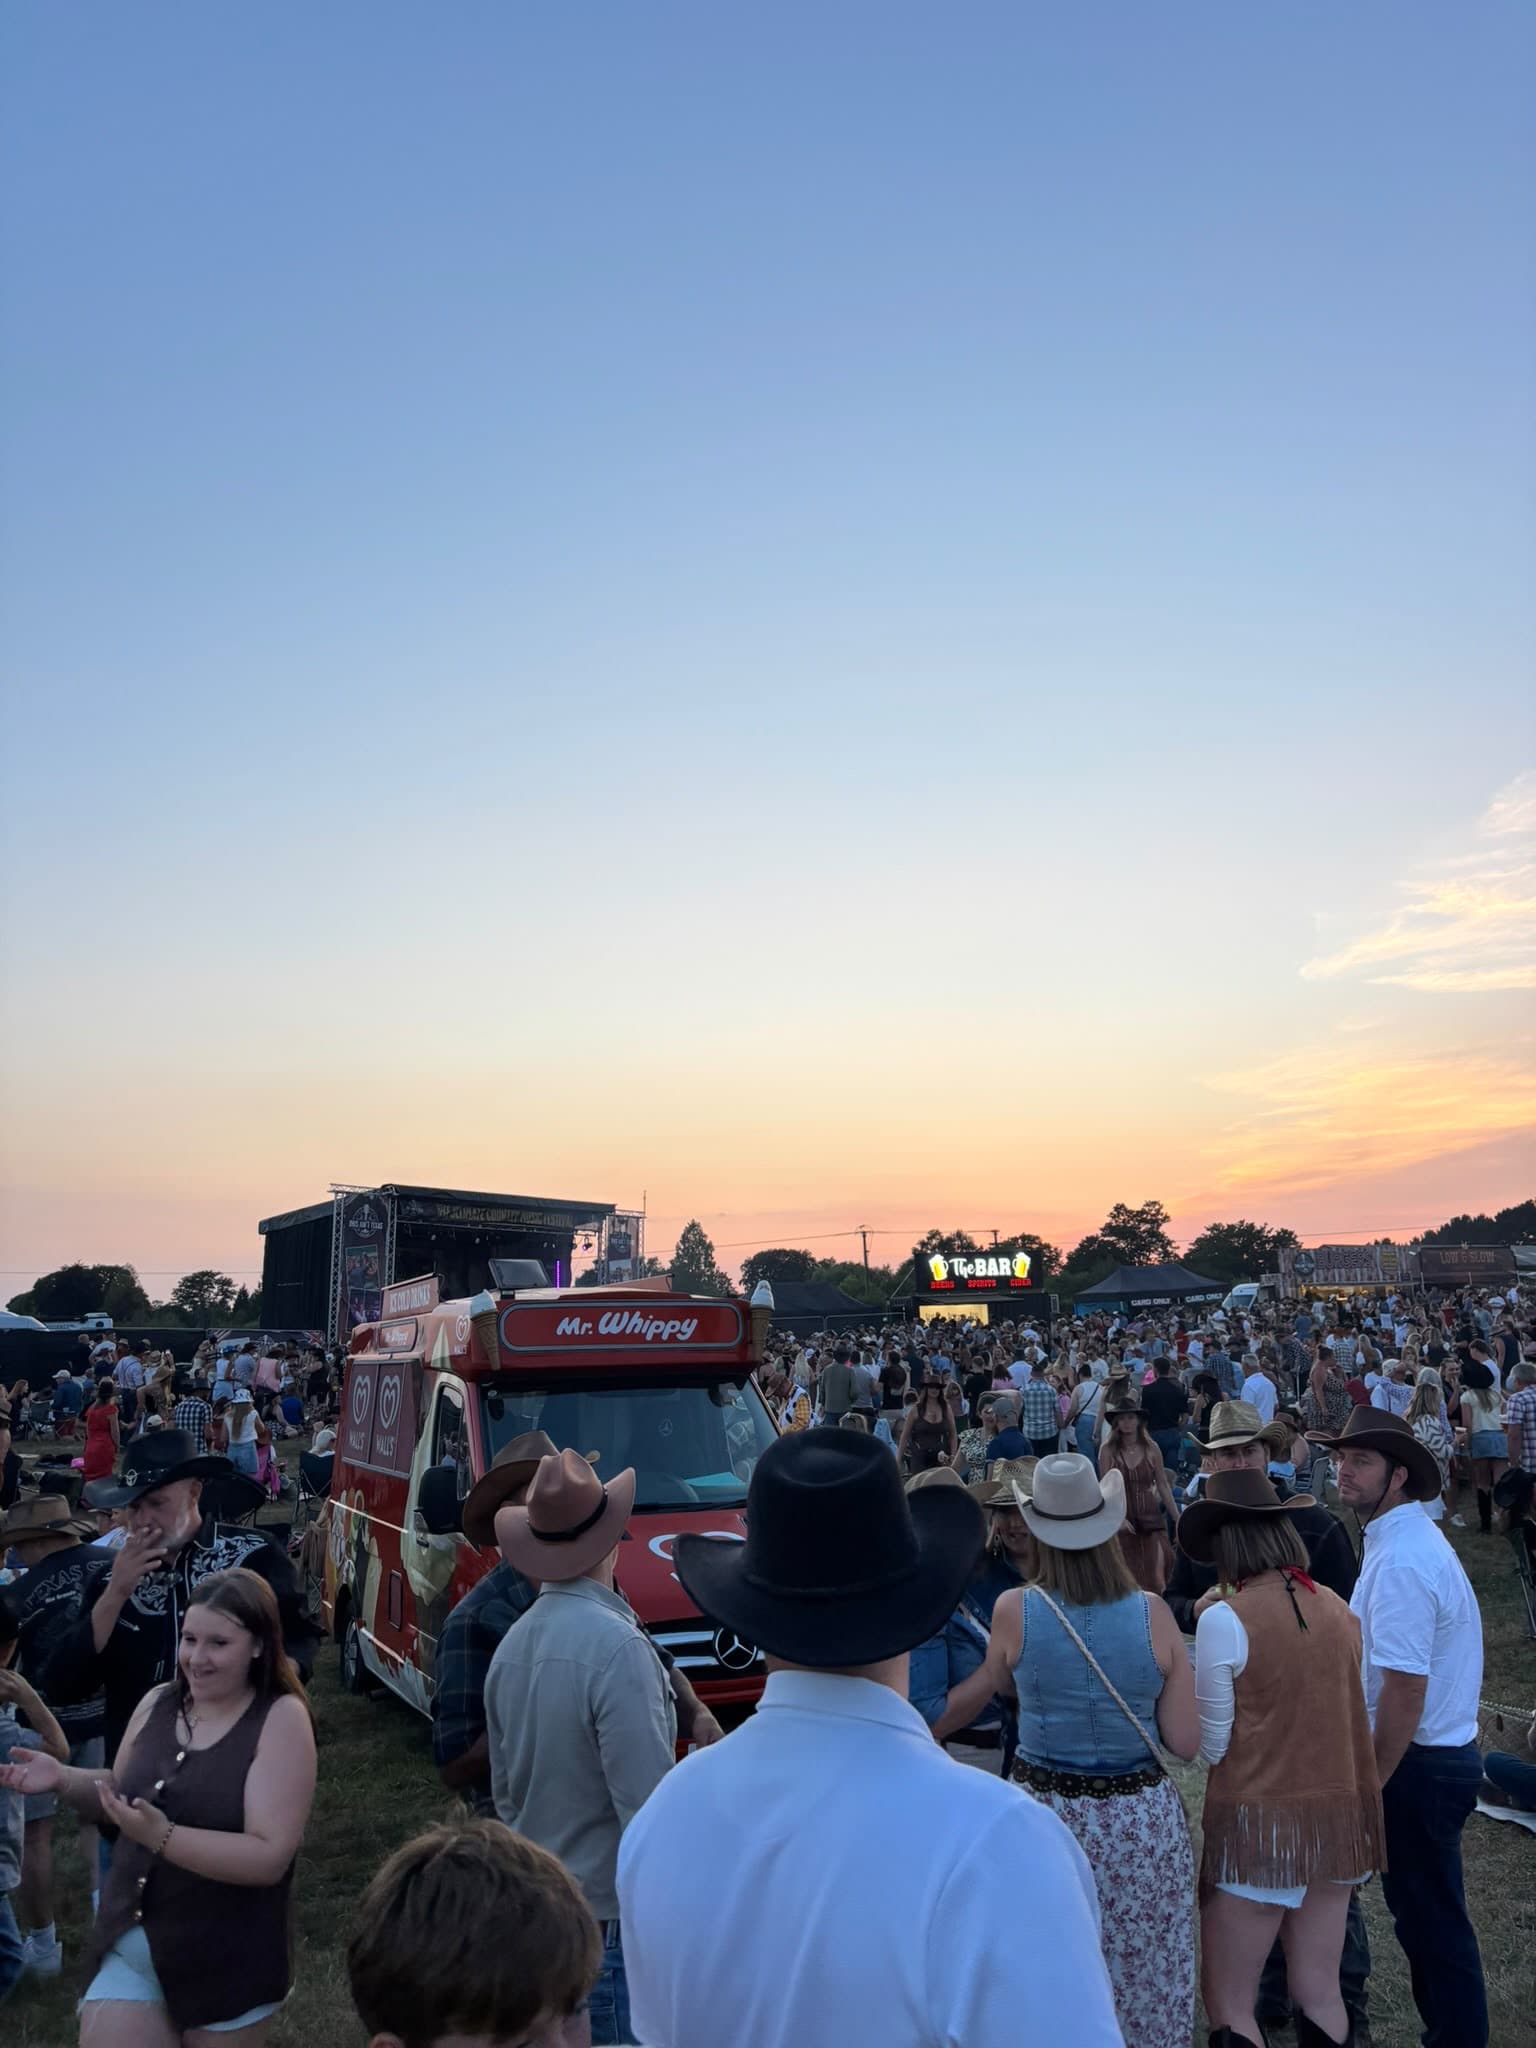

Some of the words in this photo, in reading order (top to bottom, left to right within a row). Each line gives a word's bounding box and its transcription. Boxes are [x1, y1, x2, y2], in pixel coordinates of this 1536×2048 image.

[949, 1257, 975, 1278] The
[974, 1257, 1012, 1277] BAR
[930, 1280, 955, 1289] BEERS
[967, 1279, 997, 1288] SPIRITS
[1009, 1278, 1032, 1287] CIDER
[1185, 1295, 1205, 1303] CARD
[556, 1317, 593, 1336] Mr.
[598, 1311, 698, 1341] Whippy
[24, 1564, 83, 1610] TEXAS
